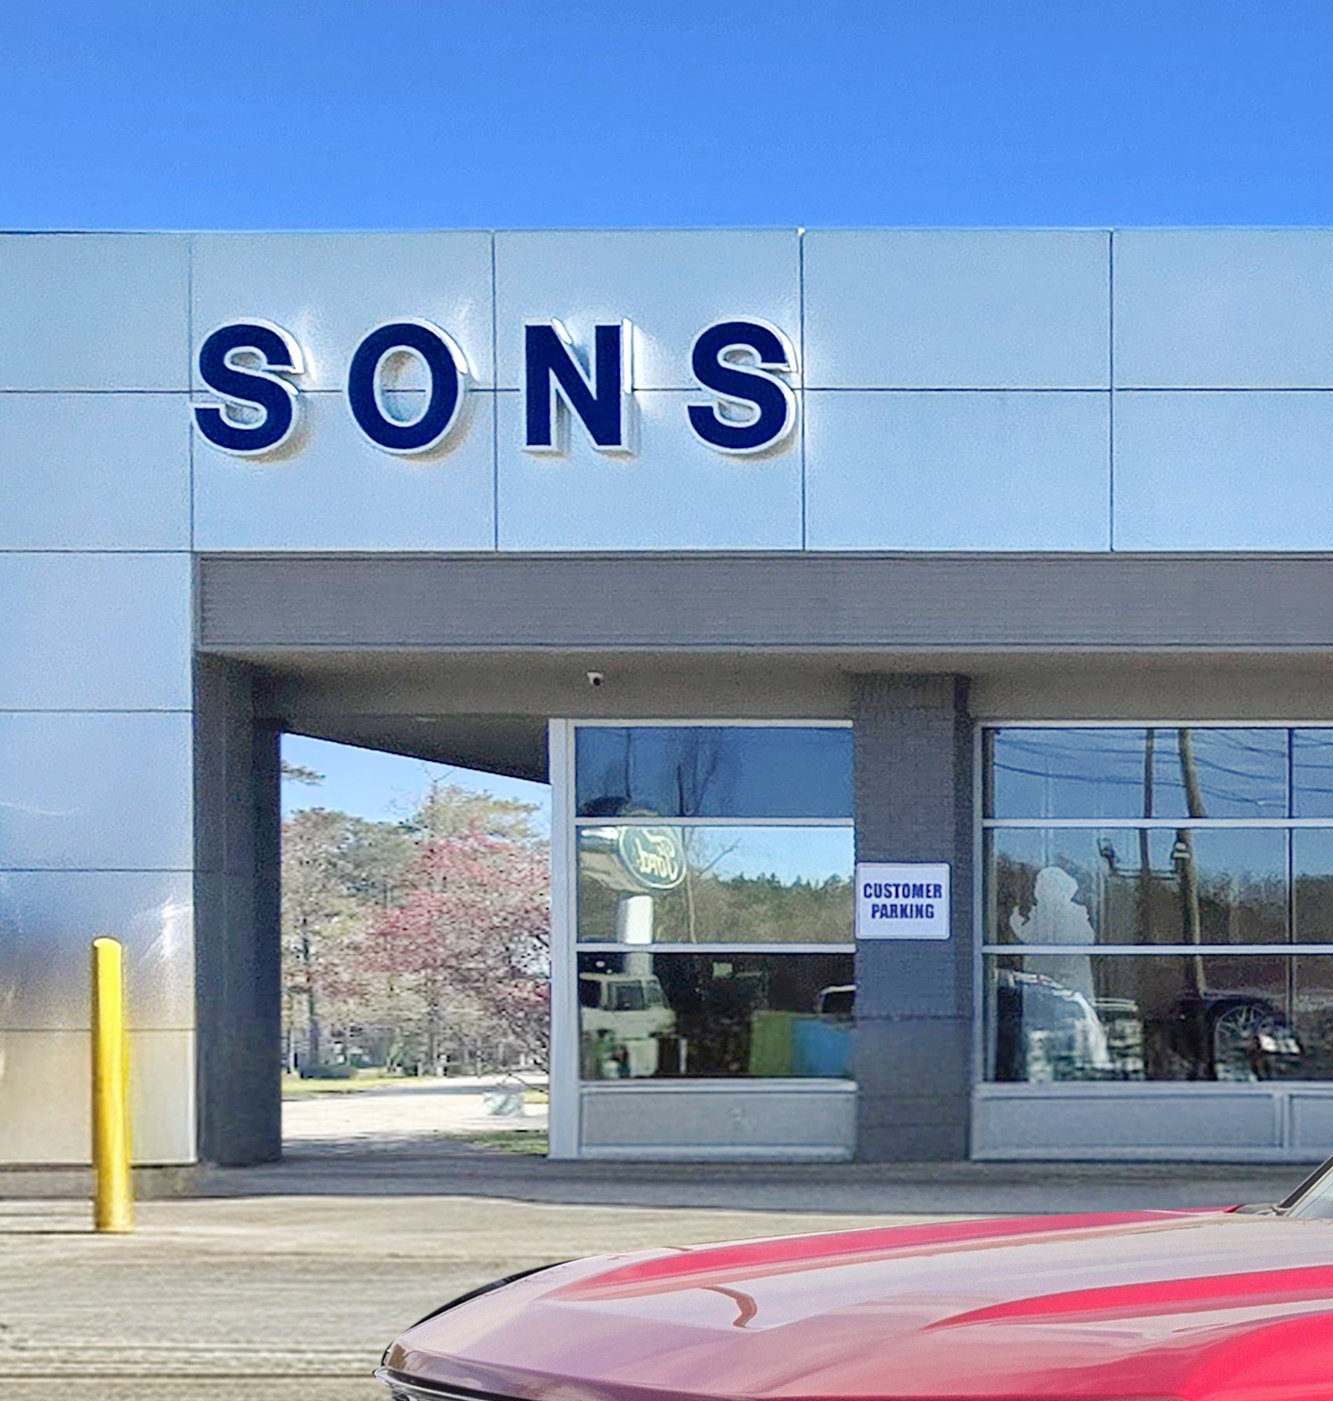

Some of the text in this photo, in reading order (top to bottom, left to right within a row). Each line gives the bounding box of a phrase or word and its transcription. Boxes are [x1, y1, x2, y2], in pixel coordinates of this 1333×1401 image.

[193, 318, 795, 454] SONS
[863, 882, 943, 899] CUSTOMER
[871, 903, 935, 919] PARKING
